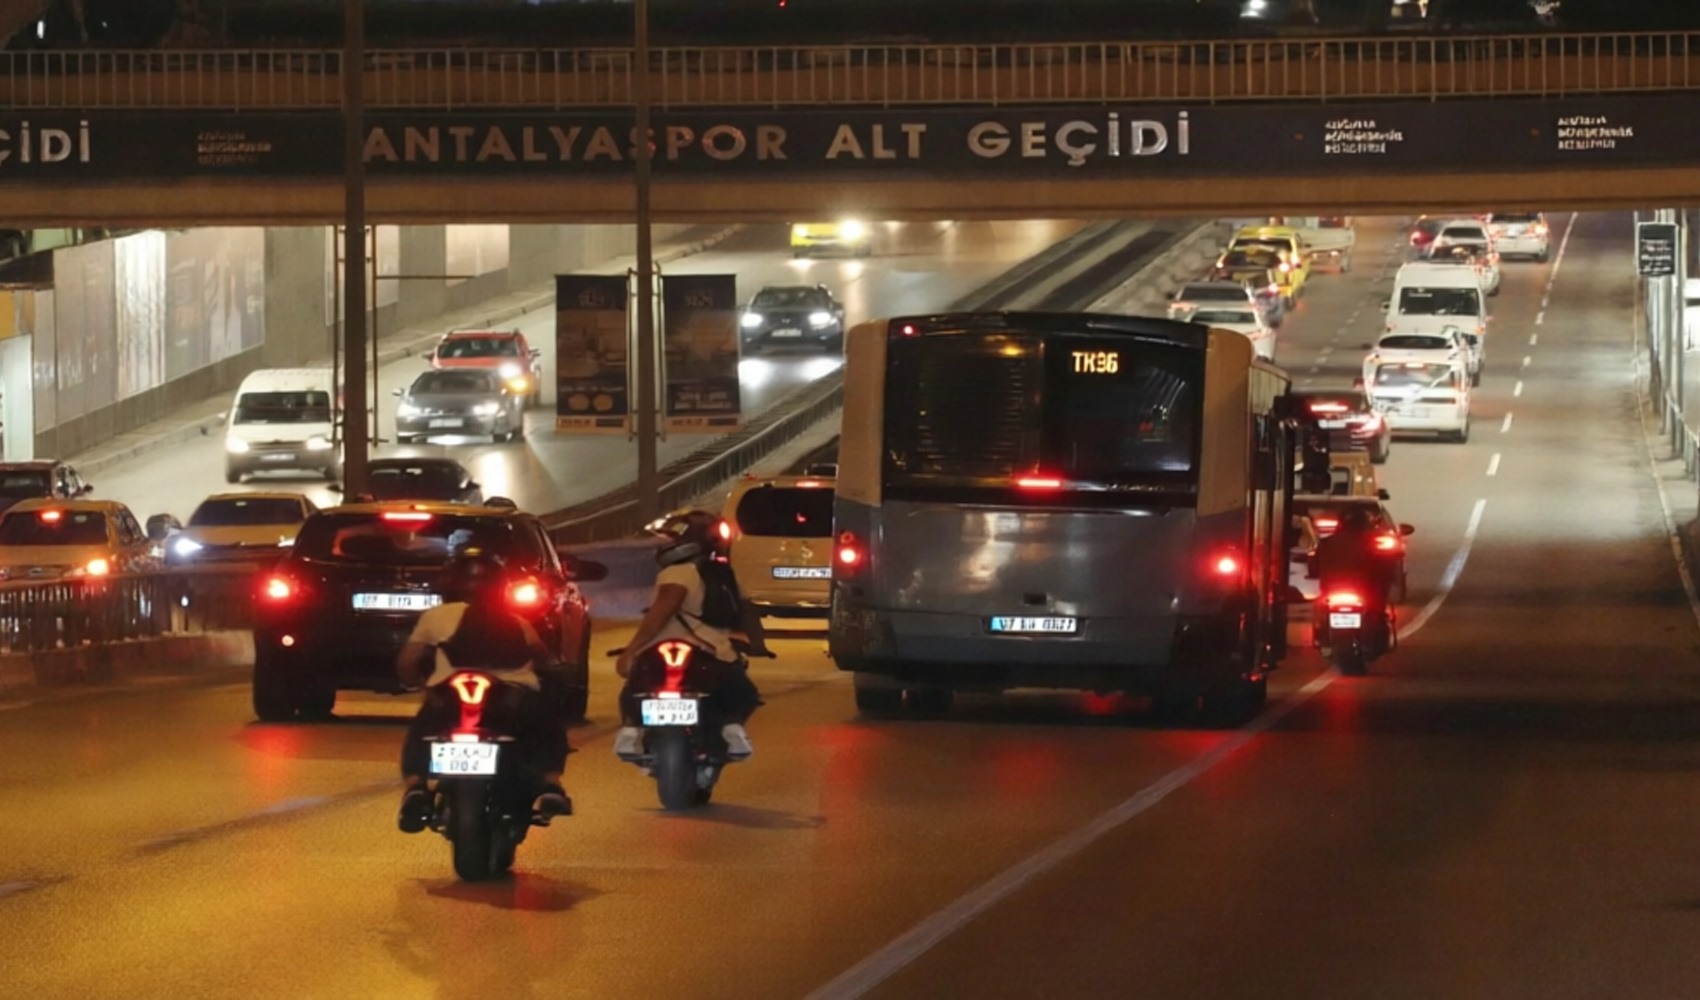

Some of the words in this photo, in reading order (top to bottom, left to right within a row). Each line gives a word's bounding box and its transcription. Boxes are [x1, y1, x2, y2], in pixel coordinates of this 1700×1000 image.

[0, 120, 90, 165] İDİ
[827, 123, 926, 159] ALT
[968, 112, 1191, 166] GEÇİDİ
